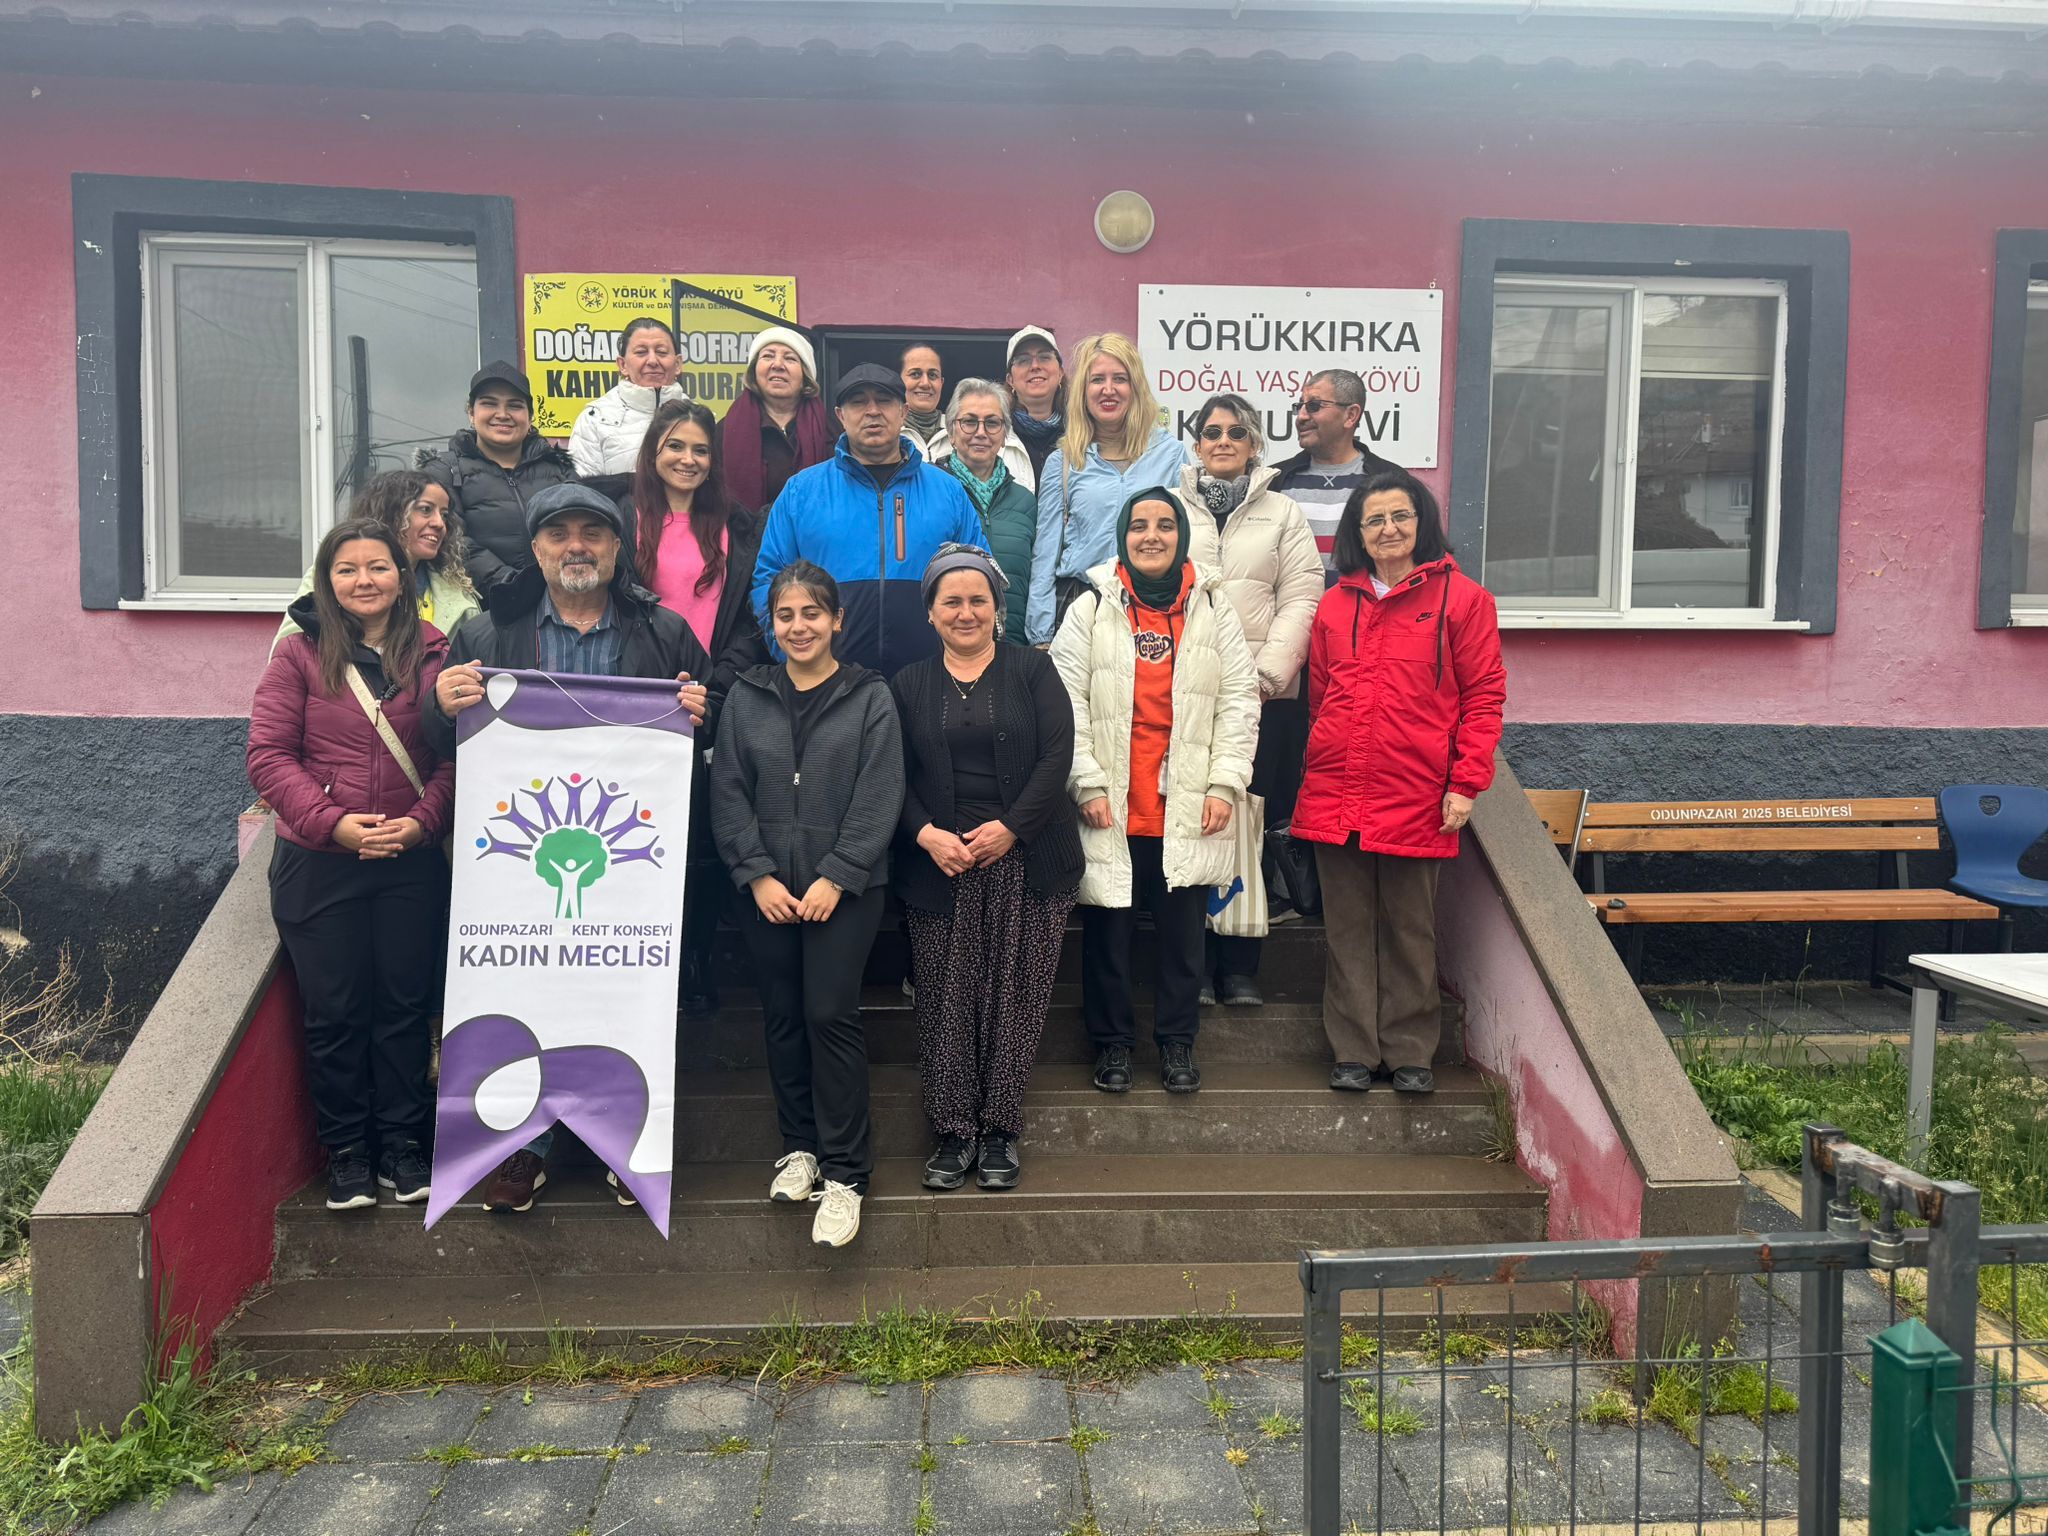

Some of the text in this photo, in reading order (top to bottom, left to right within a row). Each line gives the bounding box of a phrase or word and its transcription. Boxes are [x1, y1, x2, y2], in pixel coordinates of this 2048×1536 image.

[612, 285, 657, 298] YÖRÜK
[612, 300, 644, 308] KÜLTÜR
[1158, 312, 1421, 352] YÖRÜKKIRKA
[546, 370, 619, 398] KAHV
[1158, 363, 1248, 393] DOĞAL
[1650, 803, 1853, 821] ODUNPAZARI 2025 BELEDİYESİ
[459, 923, 673, 936] ODUNPAZARI KENT KONSEYİ
[459, 940, 671, 967] KADIN MECLİSİ
